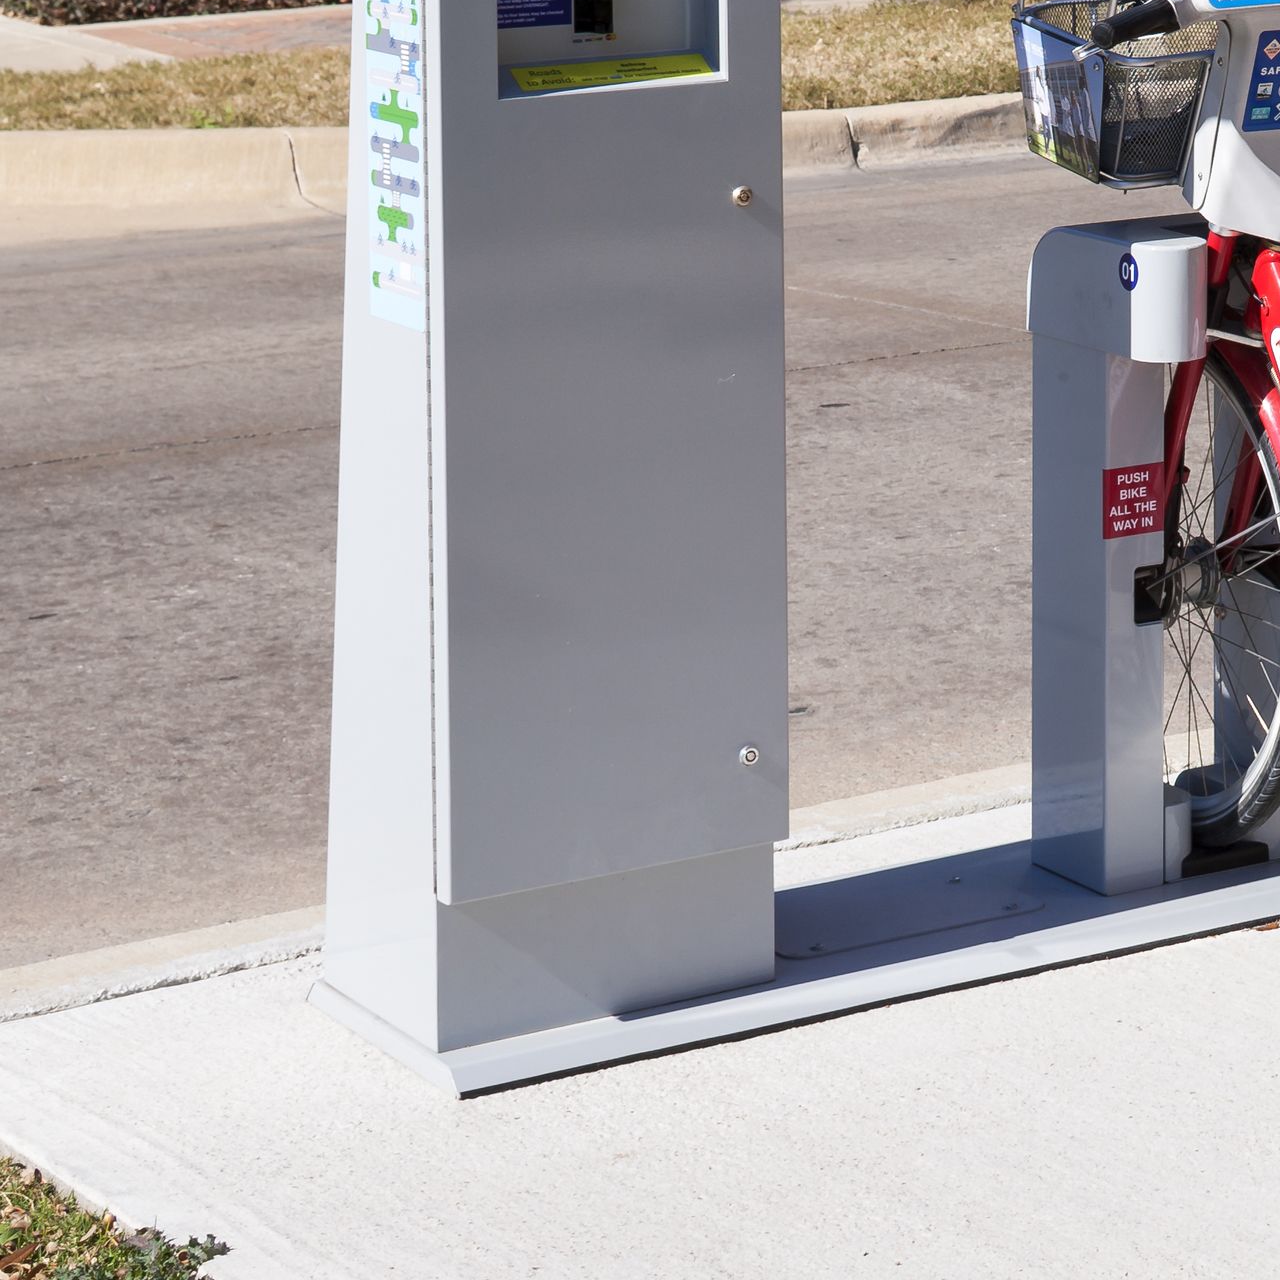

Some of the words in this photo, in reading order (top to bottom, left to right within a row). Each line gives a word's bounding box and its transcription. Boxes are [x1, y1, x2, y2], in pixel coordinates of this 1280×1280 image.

[528, 68, 562, 77] Roads
[541, 77, 576, 87] Avoid:
[1121, 261, 1136, 281] 01
[1117, 471, 1149, 485] PUSH
[1119, 486, 1147, 501] BIKE
[1109, 504, 1132, 517] ALL
[1133, 500, 1157, 513] THE
[1113, 518, 1139, 532] WAY
[1141, 515, 1153, 528] IN
